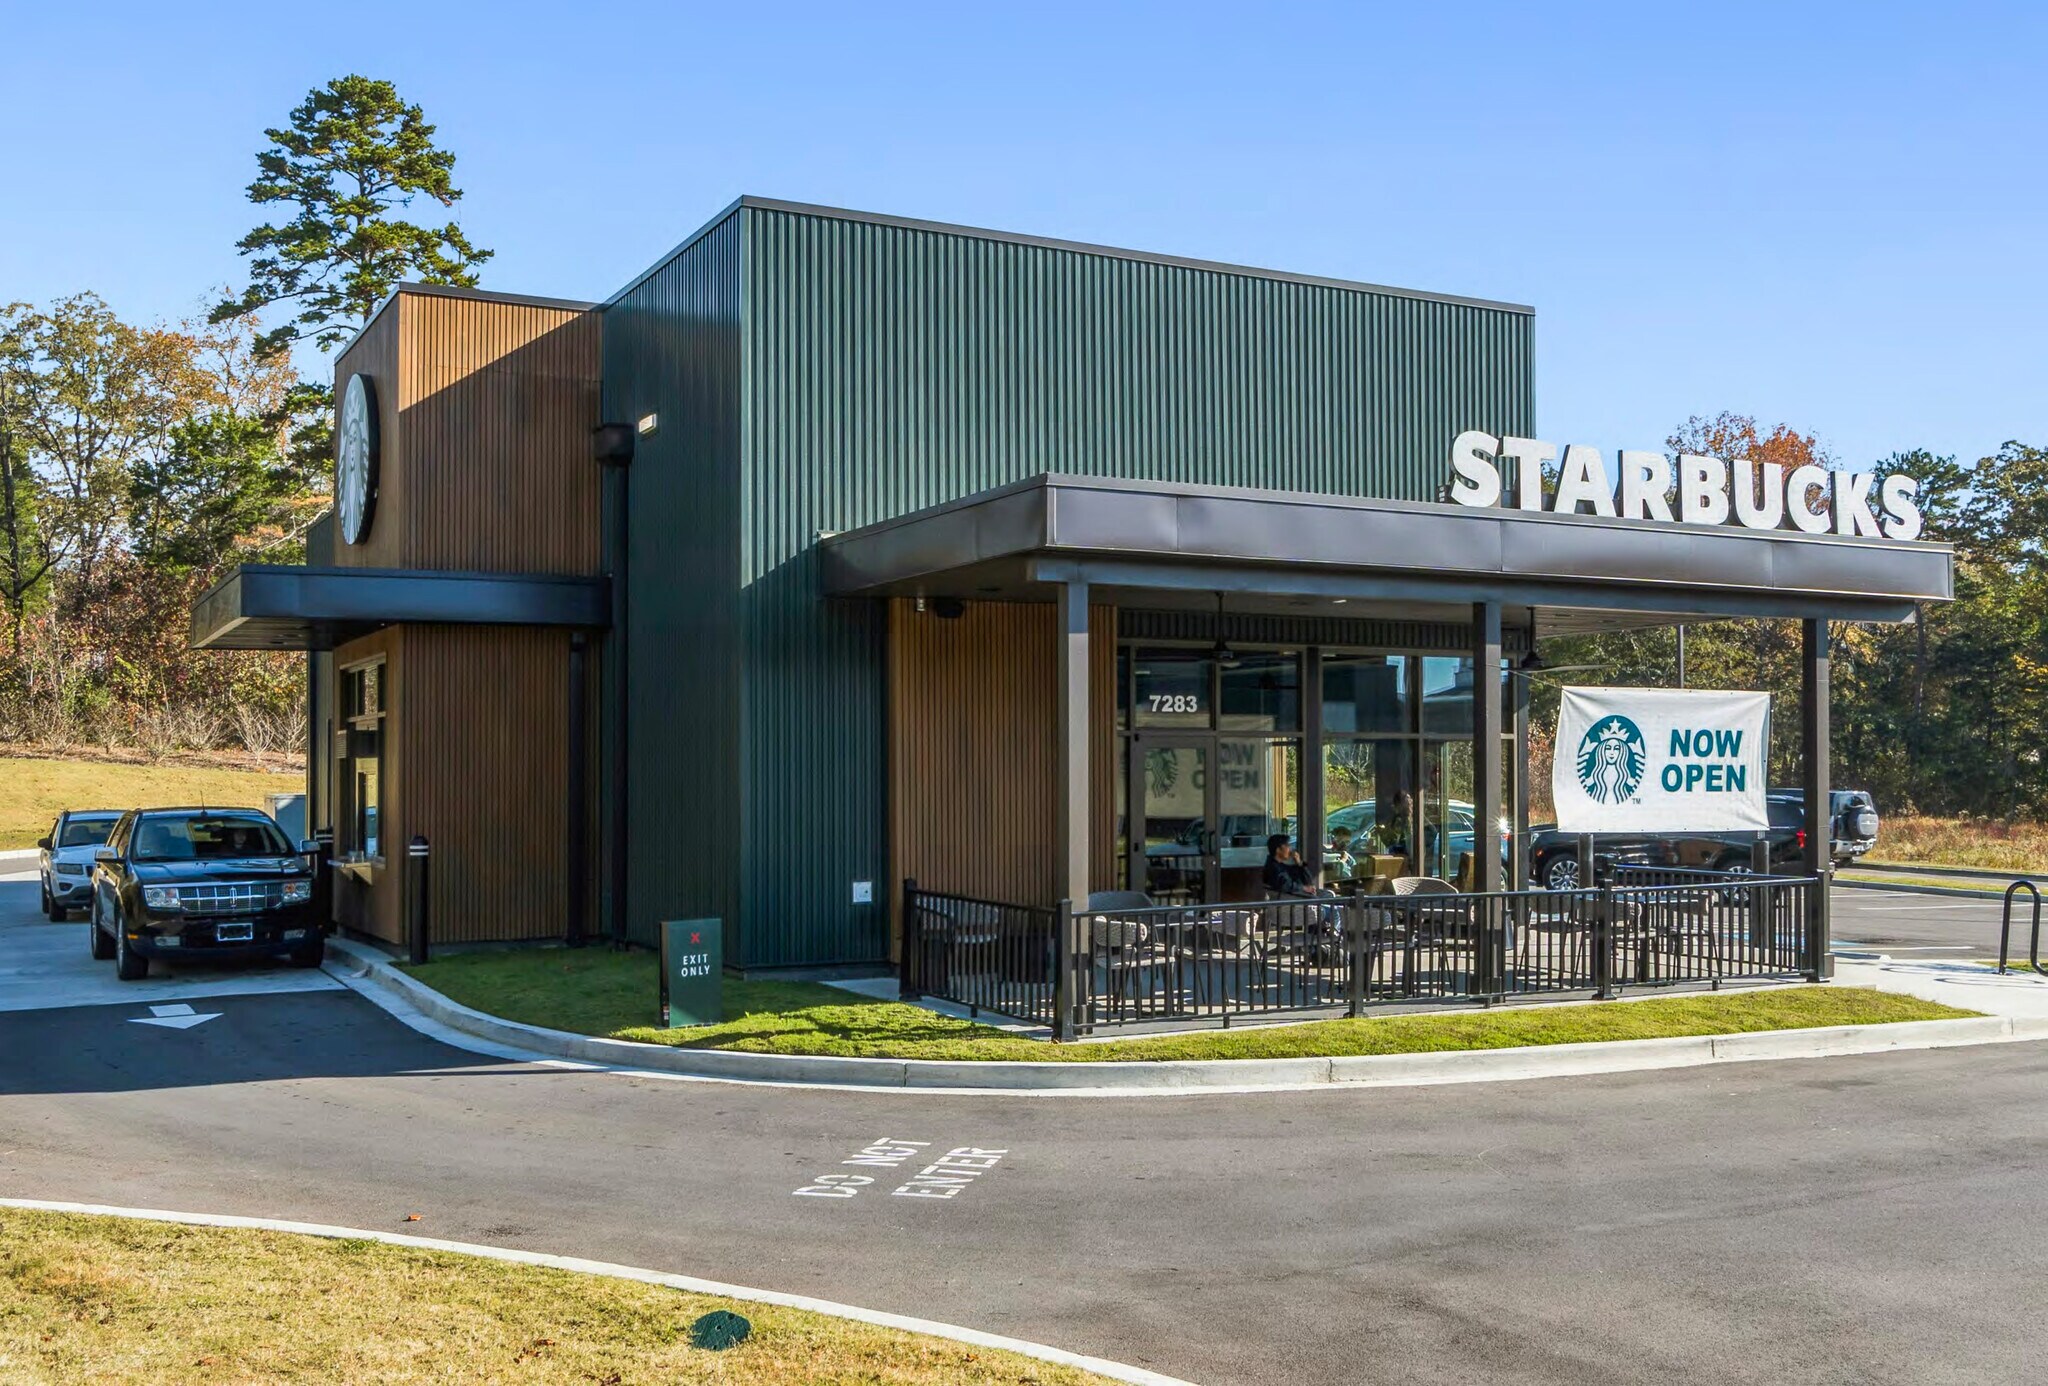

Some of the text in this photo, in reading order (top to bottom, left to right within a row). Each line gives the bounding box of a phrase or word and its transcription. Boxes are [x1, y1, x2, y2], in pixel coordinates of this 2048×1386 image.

[1450, 430, 1922, 541] STARBUCKS
[1149, 695, 1198, 713] 7283
[1669, 729, 1743, 758] NOW
[1661, 764, 1746, 793] OPEN
[681, 965, 710, 977] ONLY
[682, 953, 708, 966] EXIT
[792, 1137, 931, 1198] DO NOT
[891, 1147, 1009, 1199] ENTER
